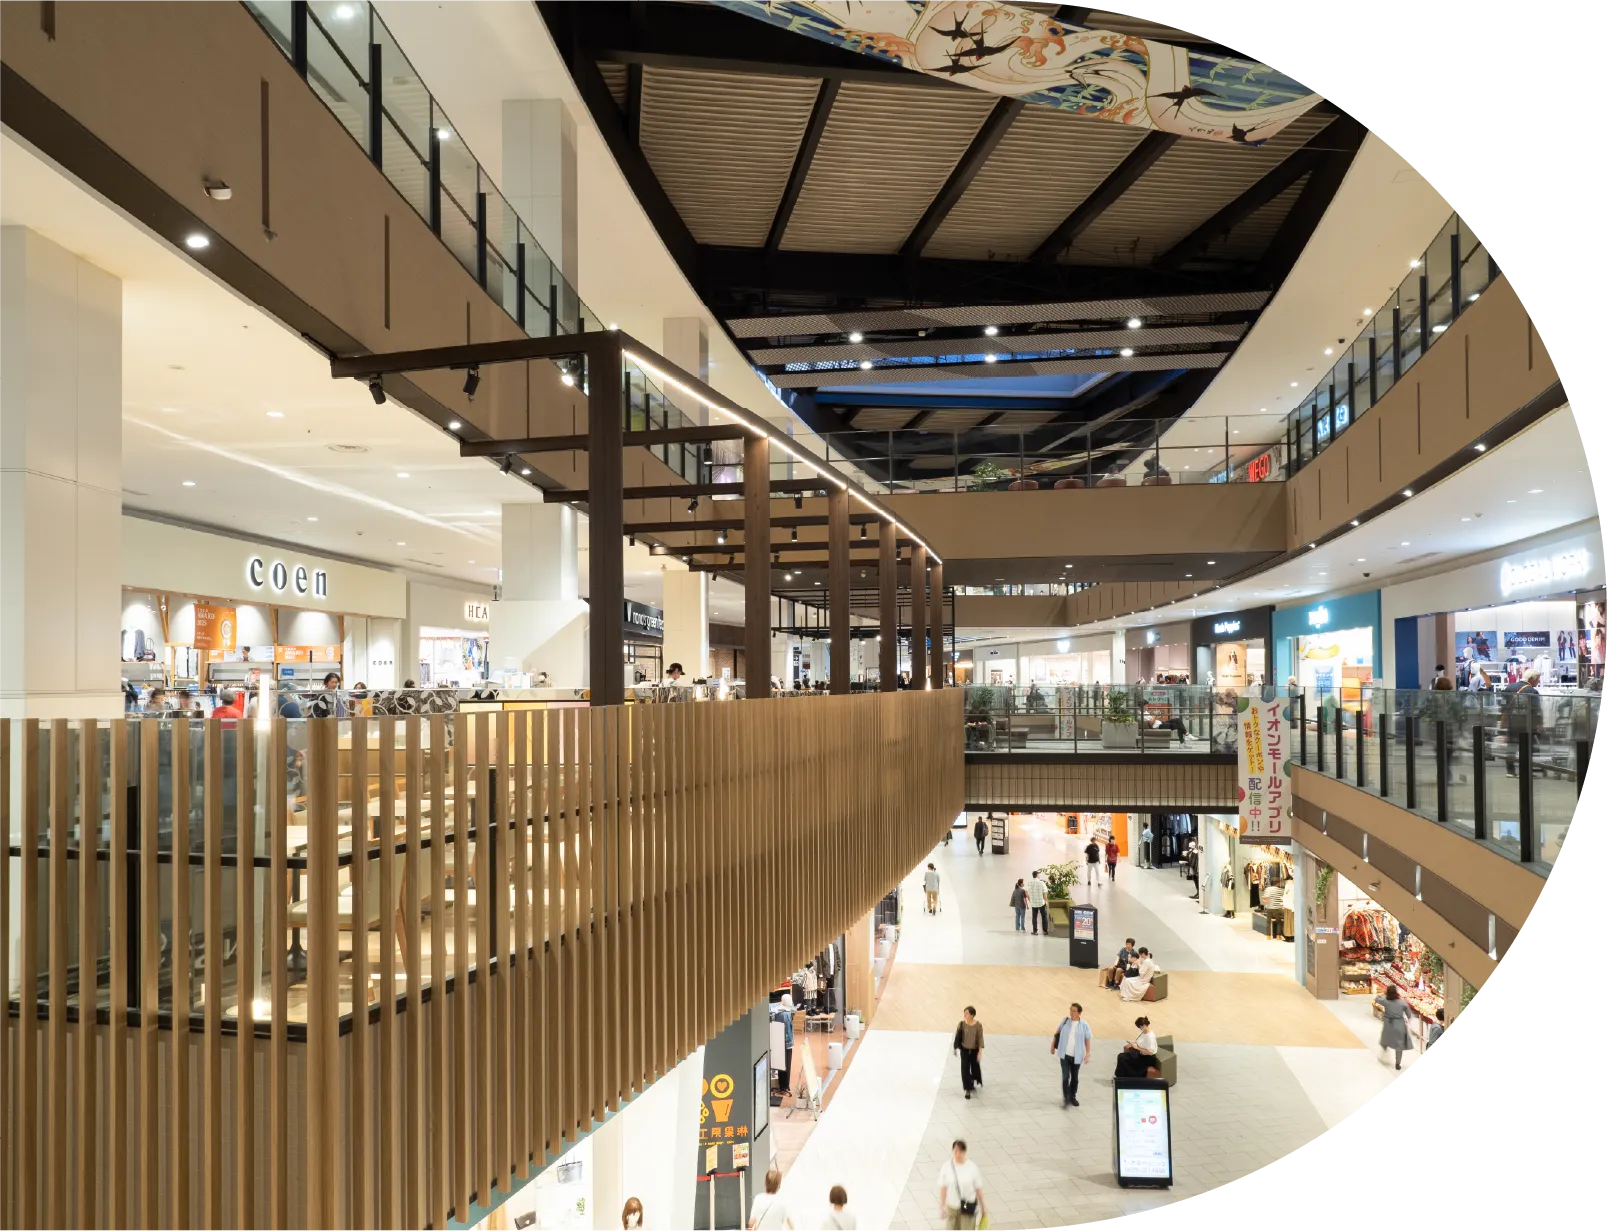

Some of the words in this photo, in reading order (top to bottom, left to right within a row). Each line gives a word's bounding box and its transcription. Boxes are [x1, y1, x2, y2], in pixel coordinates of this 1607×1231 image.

[1248, 453, 1270, 483] WEGO
[250, 558, 327, 597] coen
[1251, 707, 1265, 773] おトクなクーポンや
[1267, 703, 1283, 834] イオンモールアプリ
